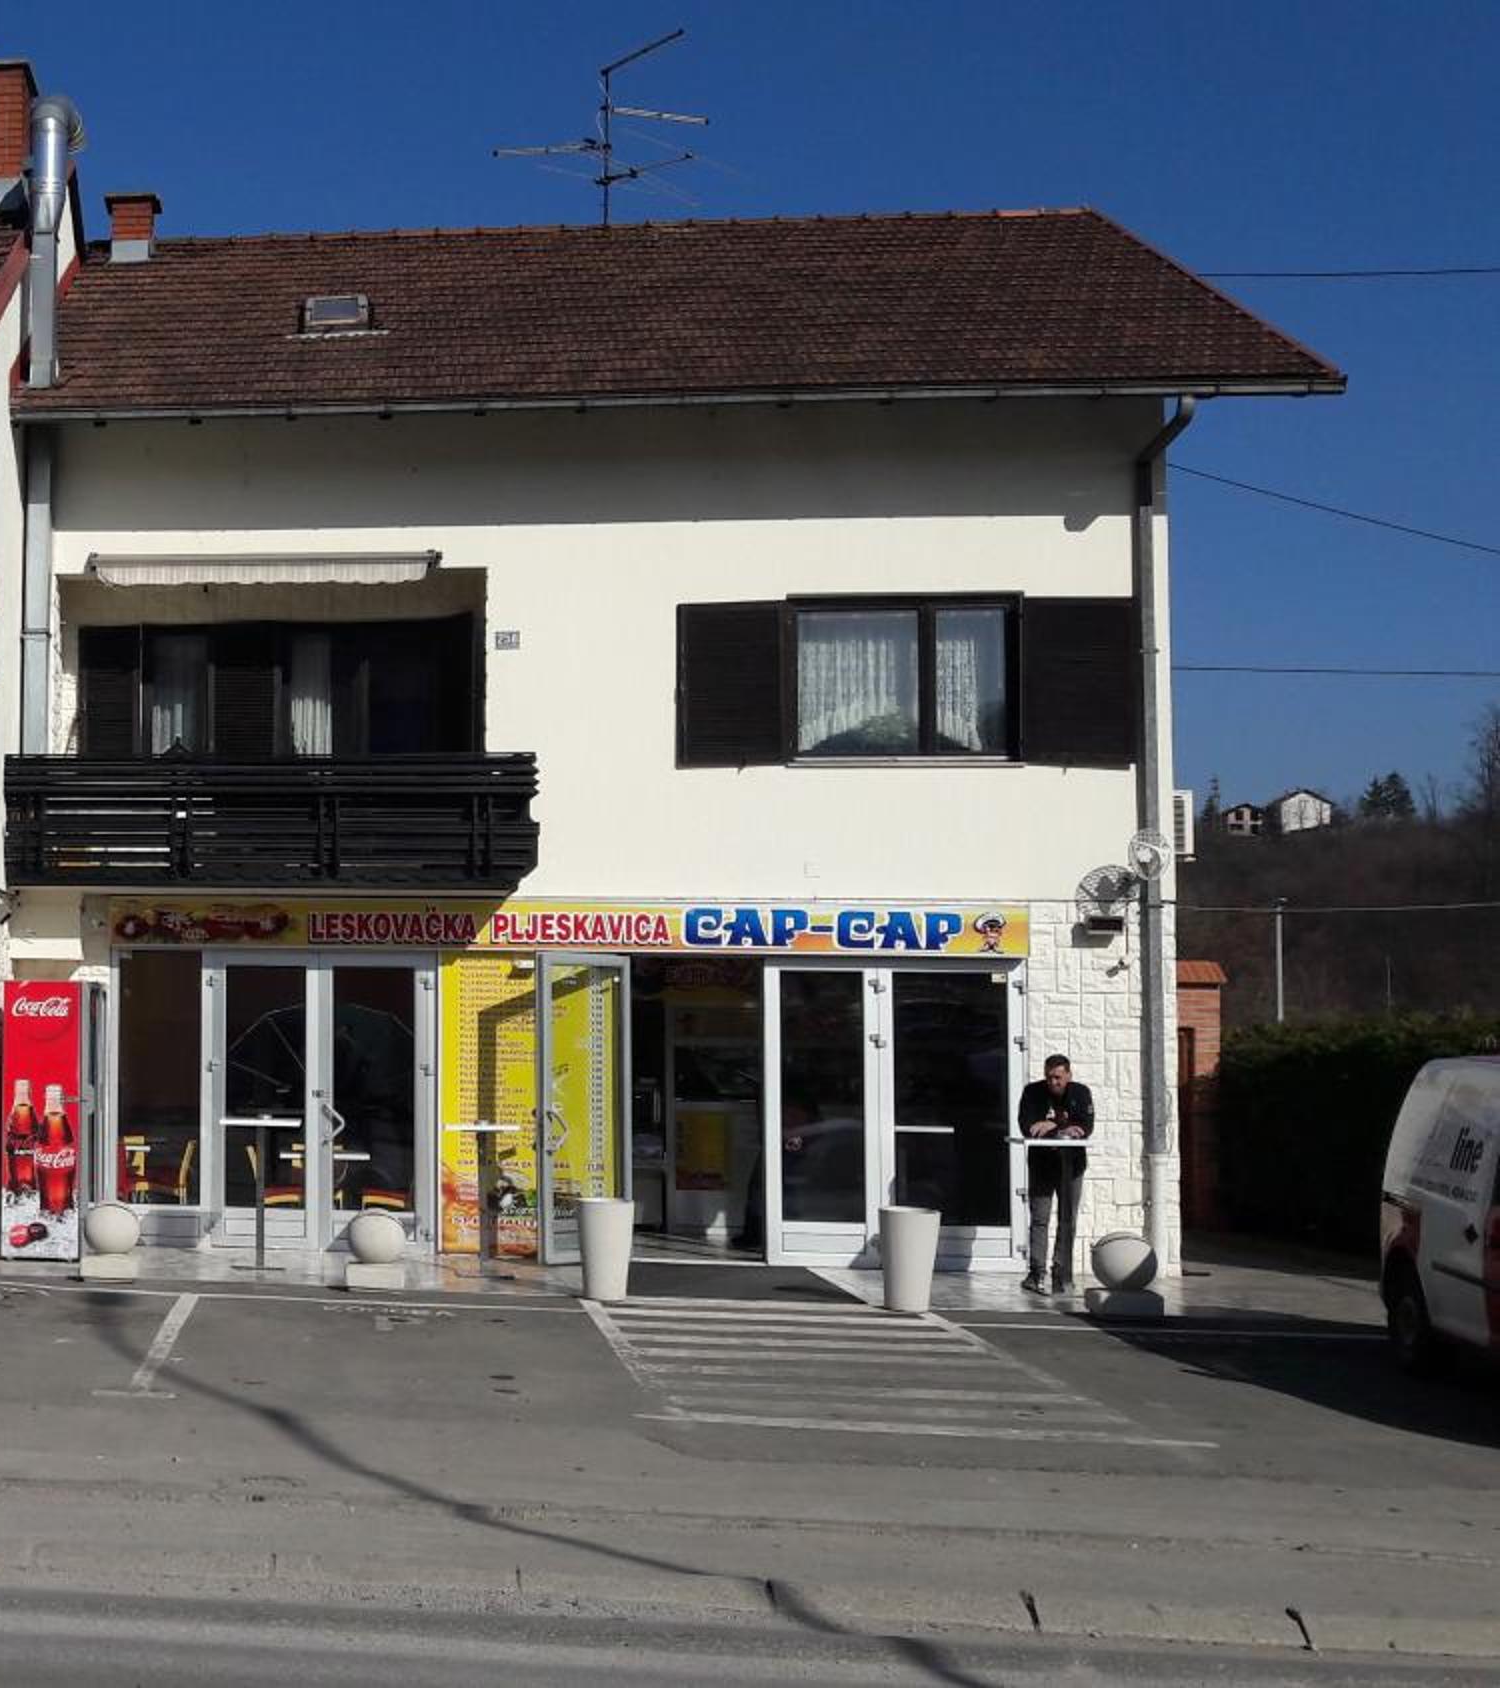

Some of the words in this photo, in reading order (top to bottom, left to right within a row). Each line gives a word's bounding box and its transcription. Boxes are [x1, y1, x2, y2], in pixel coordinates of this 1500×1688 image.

[309, 906, 478, 943] LESKOVAČKA
[490, 911, 671, 946] PLJESKAVICA
[683, 906, 964, 951] CAP-CAP
